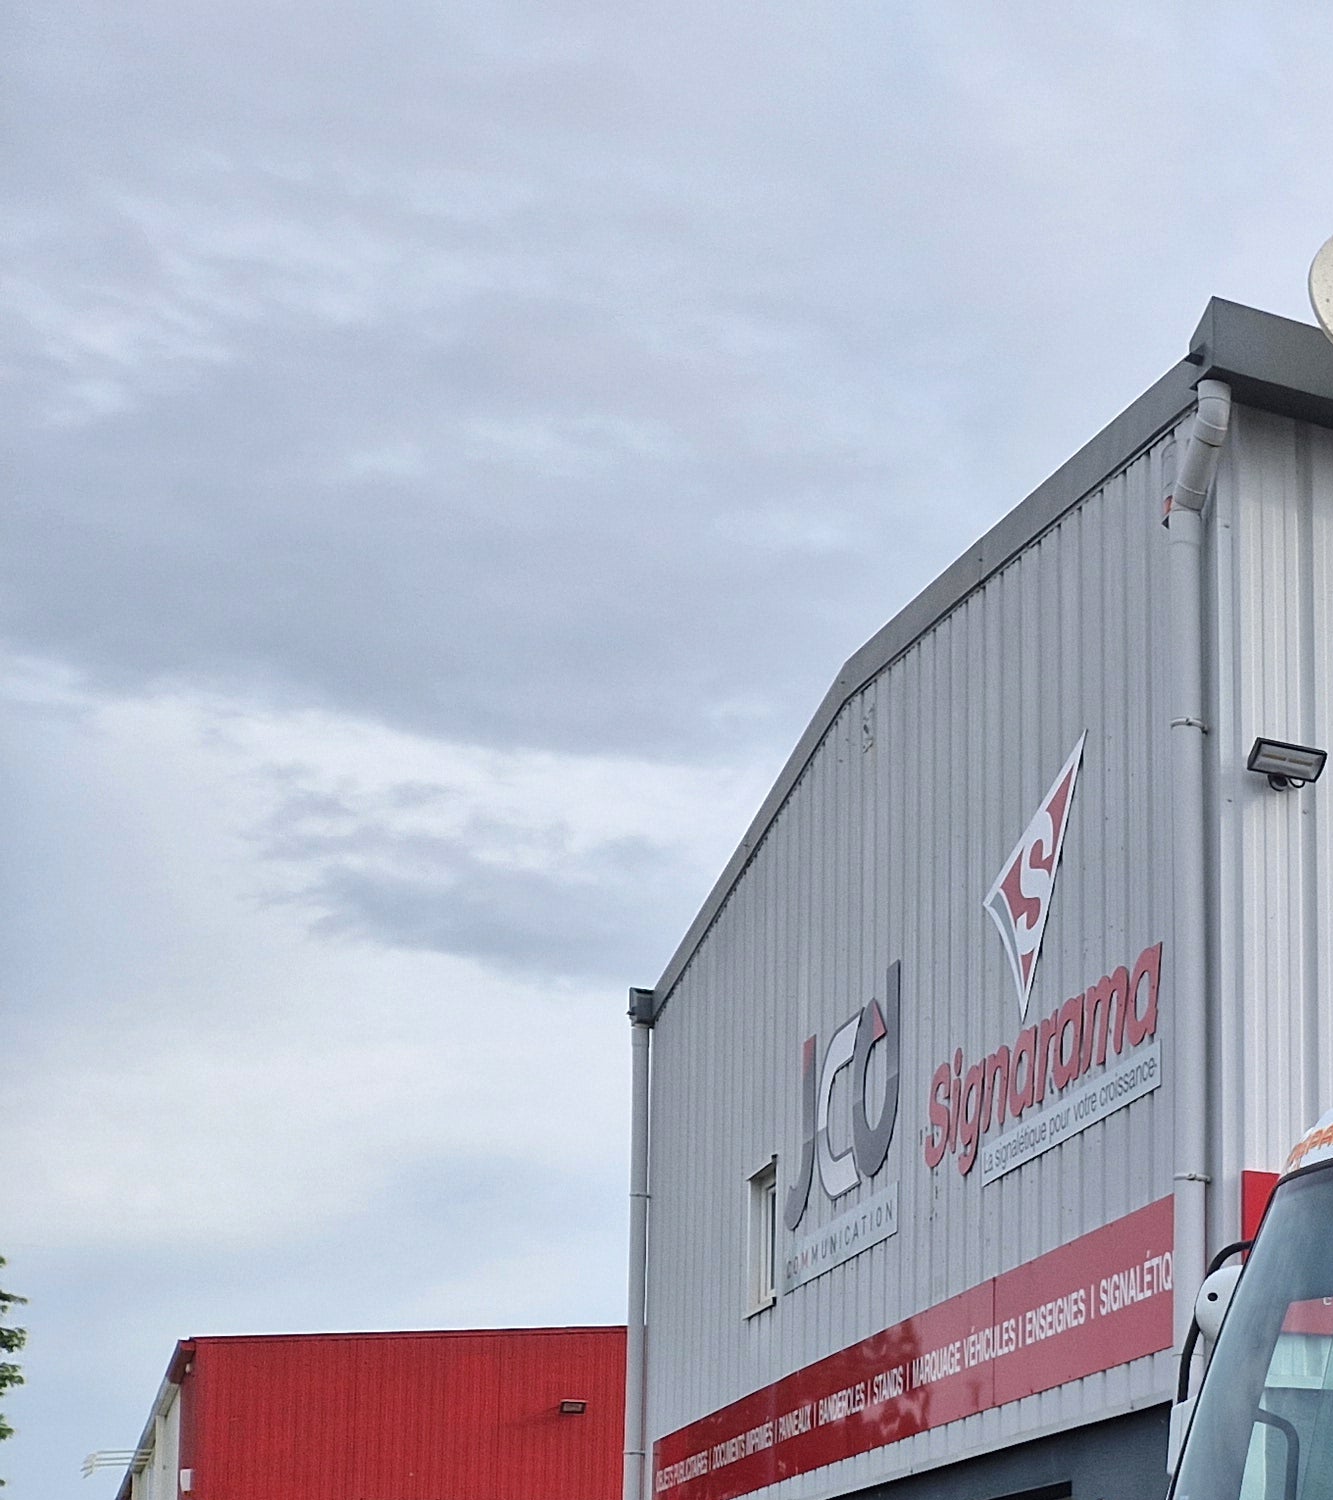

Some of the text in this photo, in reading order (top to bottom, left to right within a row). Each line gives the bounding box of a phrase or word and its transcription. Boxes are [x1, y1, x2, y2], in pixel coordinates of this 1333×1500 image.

[925, 941, 1162, 1176] Signarama
[1050, 1107, 1071, 1144] pour
[1073, 1092, 1097, 1122] votre
[786, 1199, 892, 1280] COMMUNICATION
[779, 1404, 812, 1442] PANNEAUX
[819, 1382, 864, 1426] BANDEROLES
[872, 1365, 904, 1405] STANDS
[912, 1341, 961, 1389] MARQUAGE
[963, 1317, 1016, 1370] VÉHICULES
[1026, 1288, 1086, 1346] ENSEIGNES
[1100, 1250, 1174, 1317] SIGNALÉTIQ
